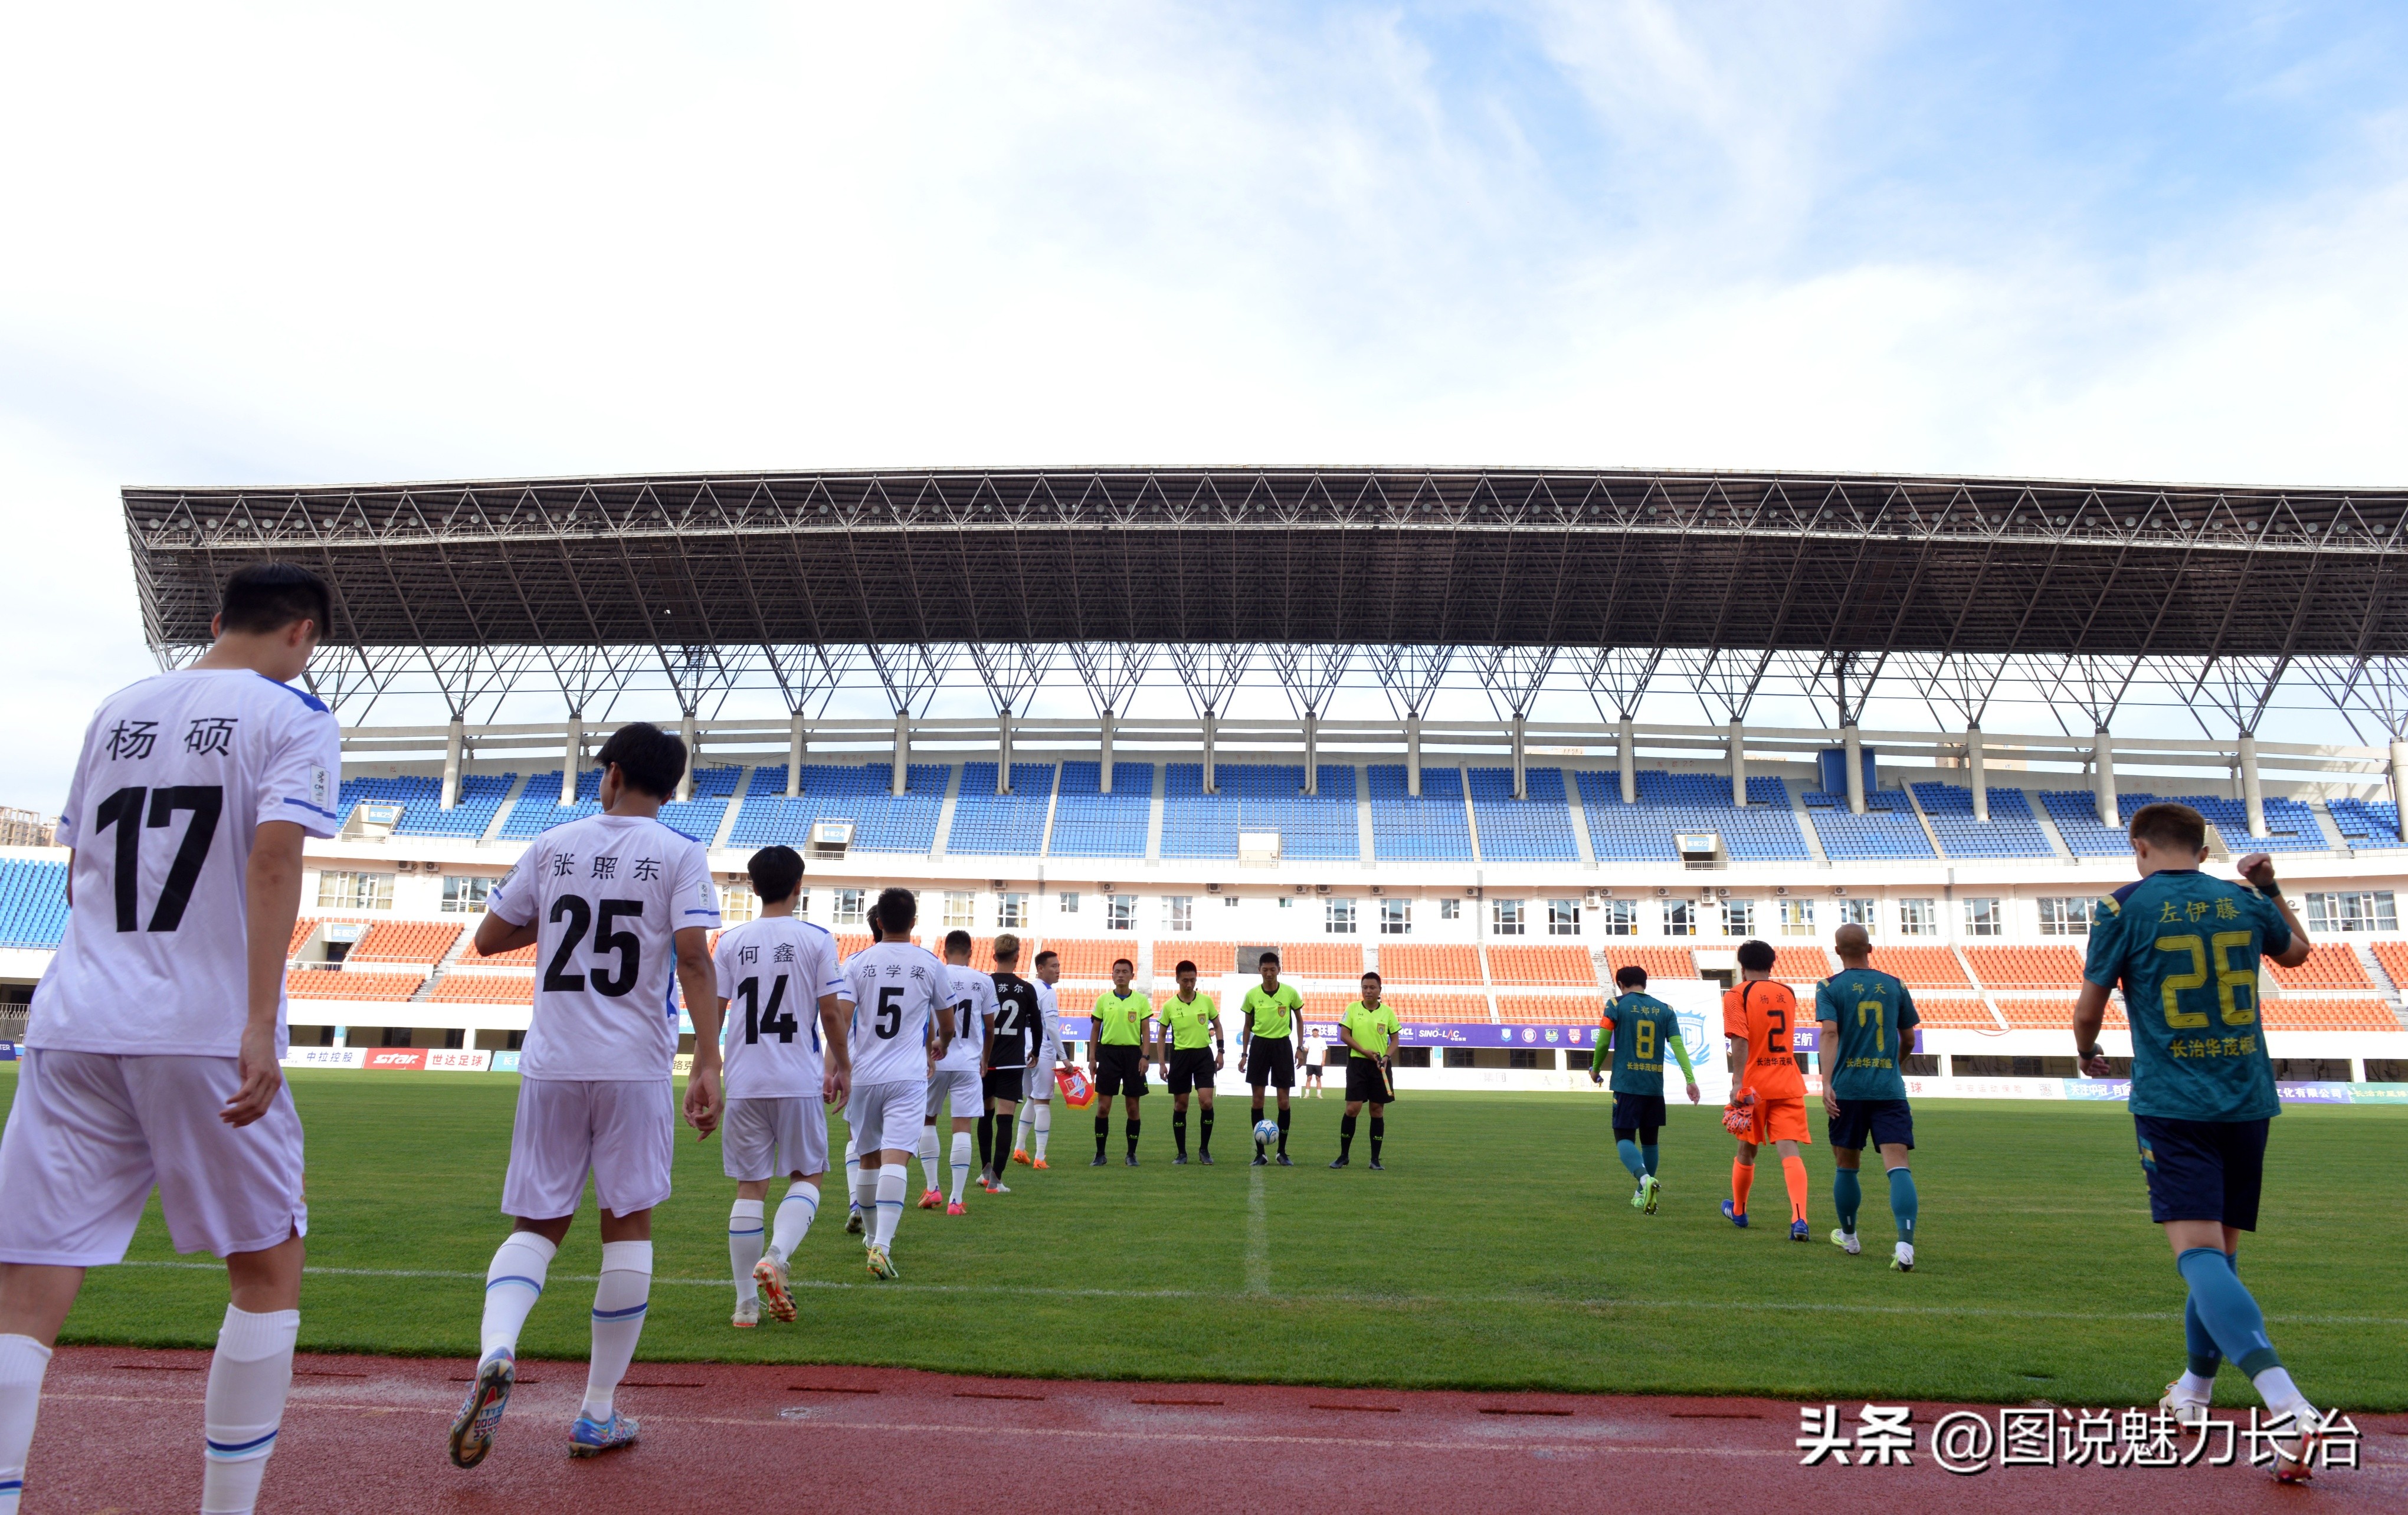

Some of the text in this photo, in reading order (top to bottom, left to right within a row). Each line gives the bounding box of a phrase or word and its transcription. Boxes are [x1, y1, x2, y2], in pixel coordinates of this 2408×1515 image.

[106, 717, 238, 761] 杨硕
[96, 785, 223, 932] 17
[554, 853, 661, 881] 张照东
[2159, 897, 2241, 923] 左伊藤
[543, 894, 643, 997] 25
[738, 943, 794, 965] 何鑫
[863, 964, 925, 980] 范学梁
[2155, 930, 2257, 1029] 26
[998, 983, 1024, 993] 苏尔
[1760, 993, 1787, 1004] 杨波
[1852, 982, 1886, 995] 邱天
[738, 974, 798, 1045] 14
[875, 987, 905, 1039] 5
[1630, 1005, 1660, 1016] 王郑印
[1418, 1028, 1460, 1039] SINO-LAC
[1767, 1009, 1787, 1053] 2
[1857, 1001, 1885, 1052] 7
[1636, 1019, 1655, 1059] 8
[306, 1051, 353, 1063] 中拉控股
[432, 1054, 483, 1067] 世达足球
[1905, 1081, 1922, 1093] 球
[1955, 1084, 2022, 1093] 平安运动保险
